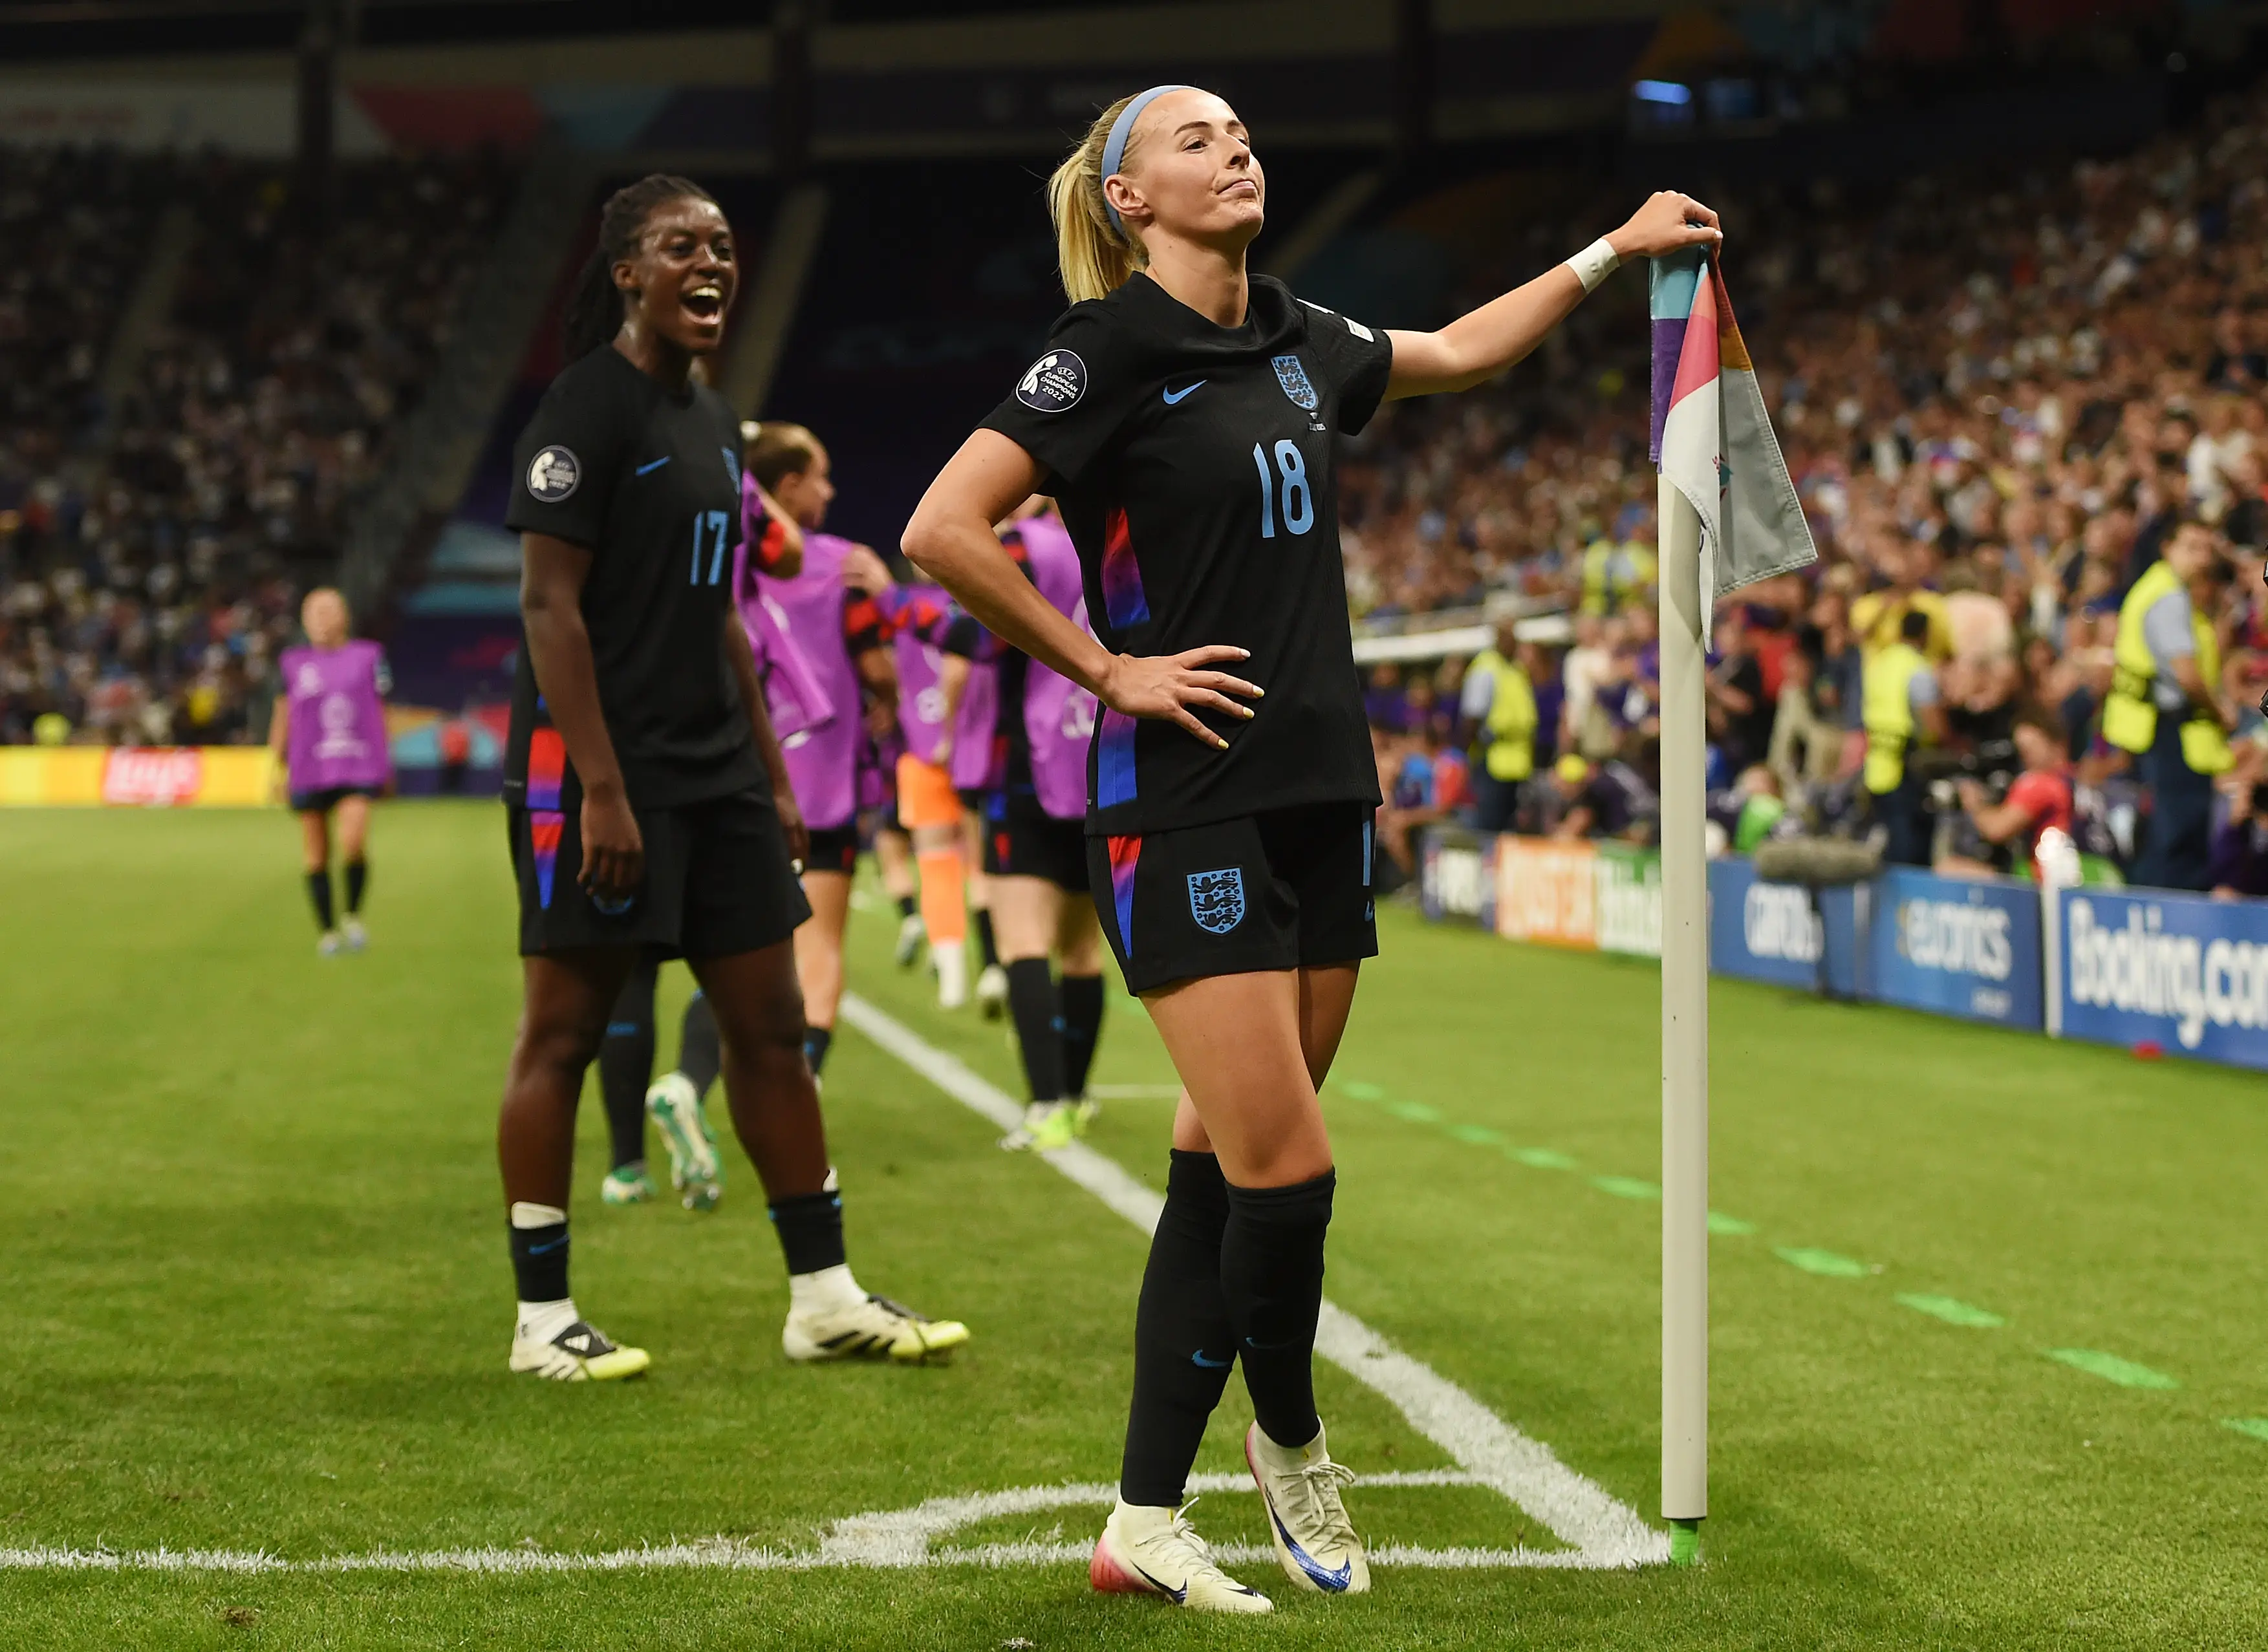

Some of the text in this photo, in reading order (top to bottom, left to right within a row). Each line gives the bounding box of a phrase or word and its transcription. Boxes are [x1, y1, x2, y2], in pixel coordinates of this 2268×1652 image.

[1045, 372, 1078, 392] EUROPEAN
[1057, 367, 1077, 381] UEFA
[1040, 376, 1076, 399] CHAMPIONS
[1042, 385, 1064, 402] 2022
[1253, 439, 1314, 539] 18
[689, 510, 729, 586] 17
